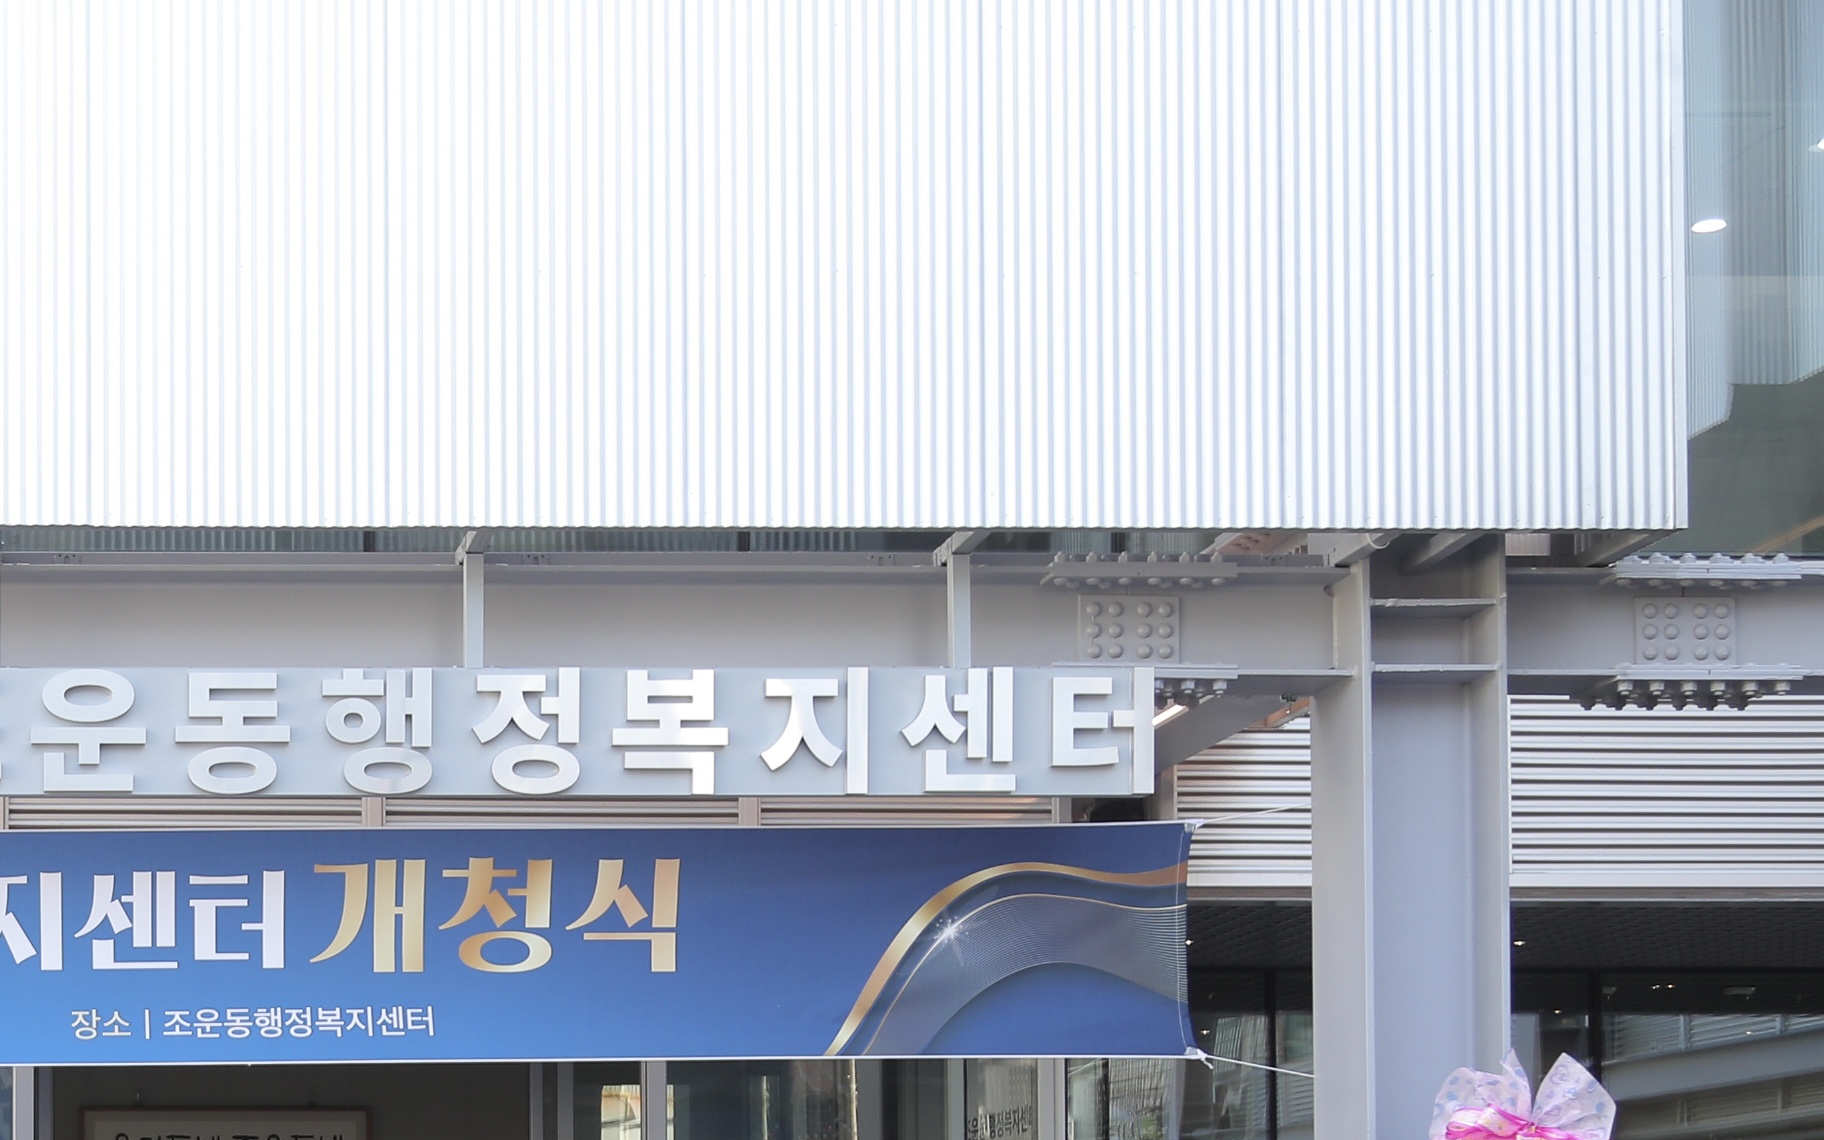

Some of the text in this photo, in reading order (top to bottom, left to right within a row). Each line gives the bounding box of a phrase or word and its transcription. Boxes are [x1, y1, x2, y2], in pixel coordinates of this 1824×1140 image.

[308, 855, 682, 974] 개청식
[70, 1007, 131, 1040] 장소
[162, 1004, 435, 1039] 조운동행정복지센터
